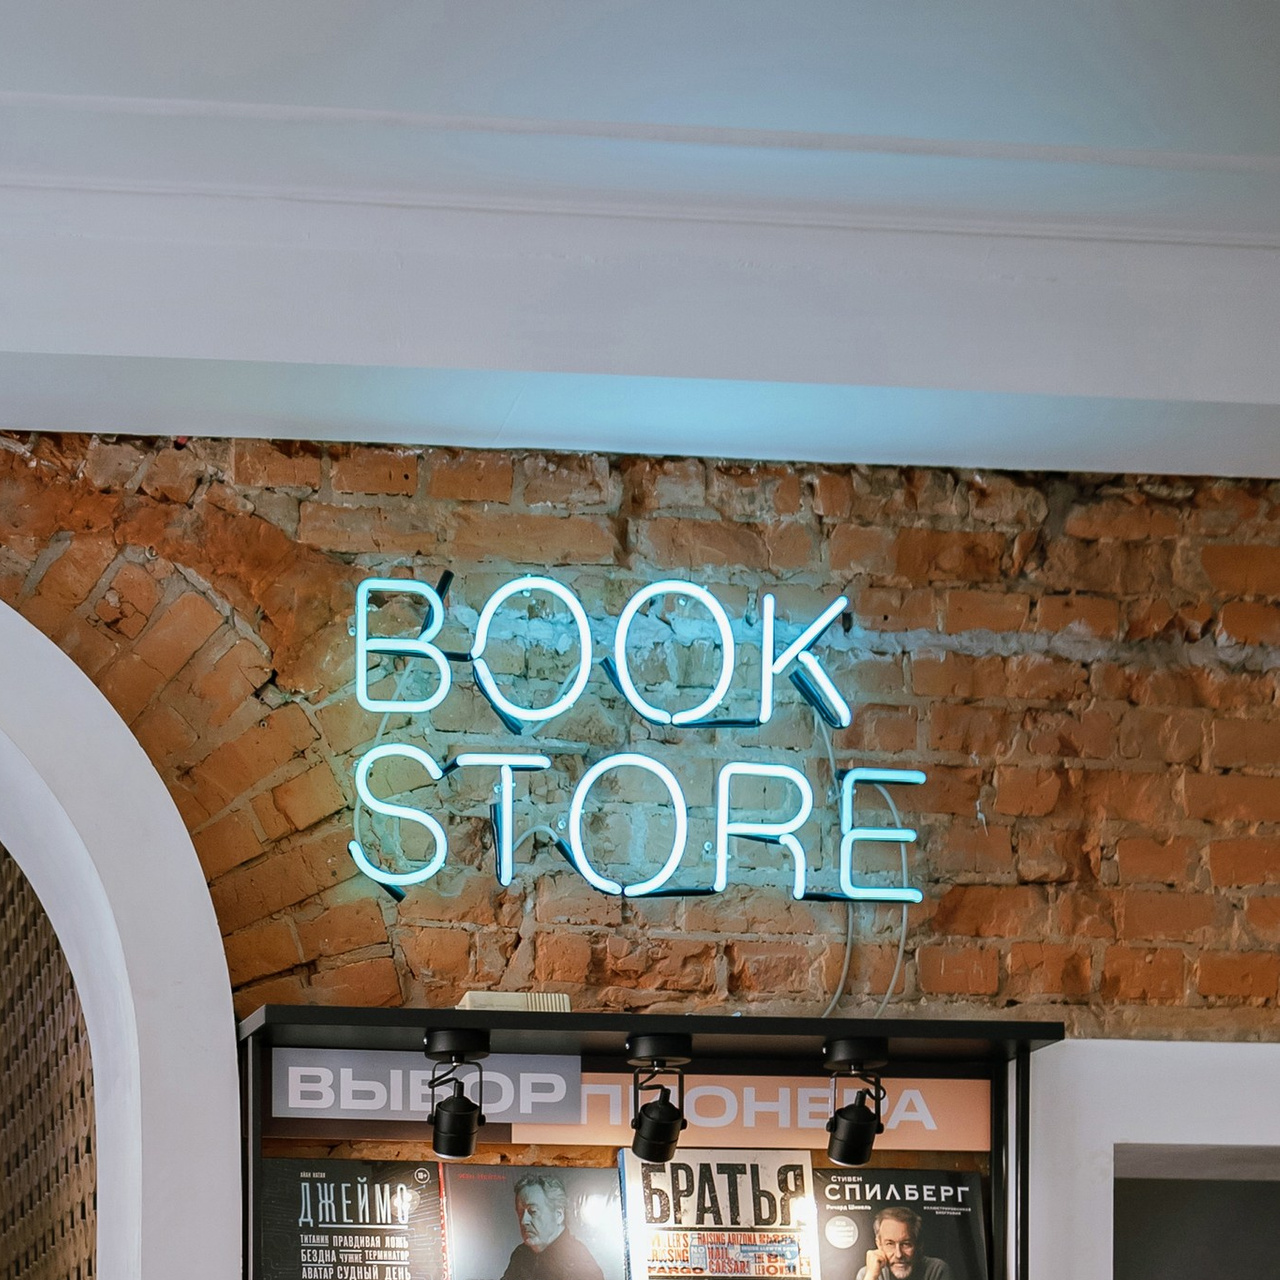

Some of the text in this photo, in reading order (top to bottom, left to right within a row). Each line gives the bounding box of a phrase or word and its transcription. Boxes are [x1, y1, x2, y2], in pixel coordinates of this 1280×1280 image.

[355, 575, 850, 728] BOOK
[348, 743, 926, 902] STORE
[641, 1162, 806, 1226] БРАТЬЯ
[824, 1183, 970, 1203] СПИЛБЕРГ
[300, 1234, 409, 1249] ТИТАНИК ПРАВДИВАЯ ЛОЖЬ
[727, 1233, 758, 1246] ARIZONA
[301, 1249, 410, 1265] БЕЗДНА ЧУЖИЕ ТЕРМИНАТОР
[301, 1266, 334, 1280] АВАТАР
[336, 1264, 380, 1280] СУДНЫЙ
[647, 1266, 705, 1275] FARGO
